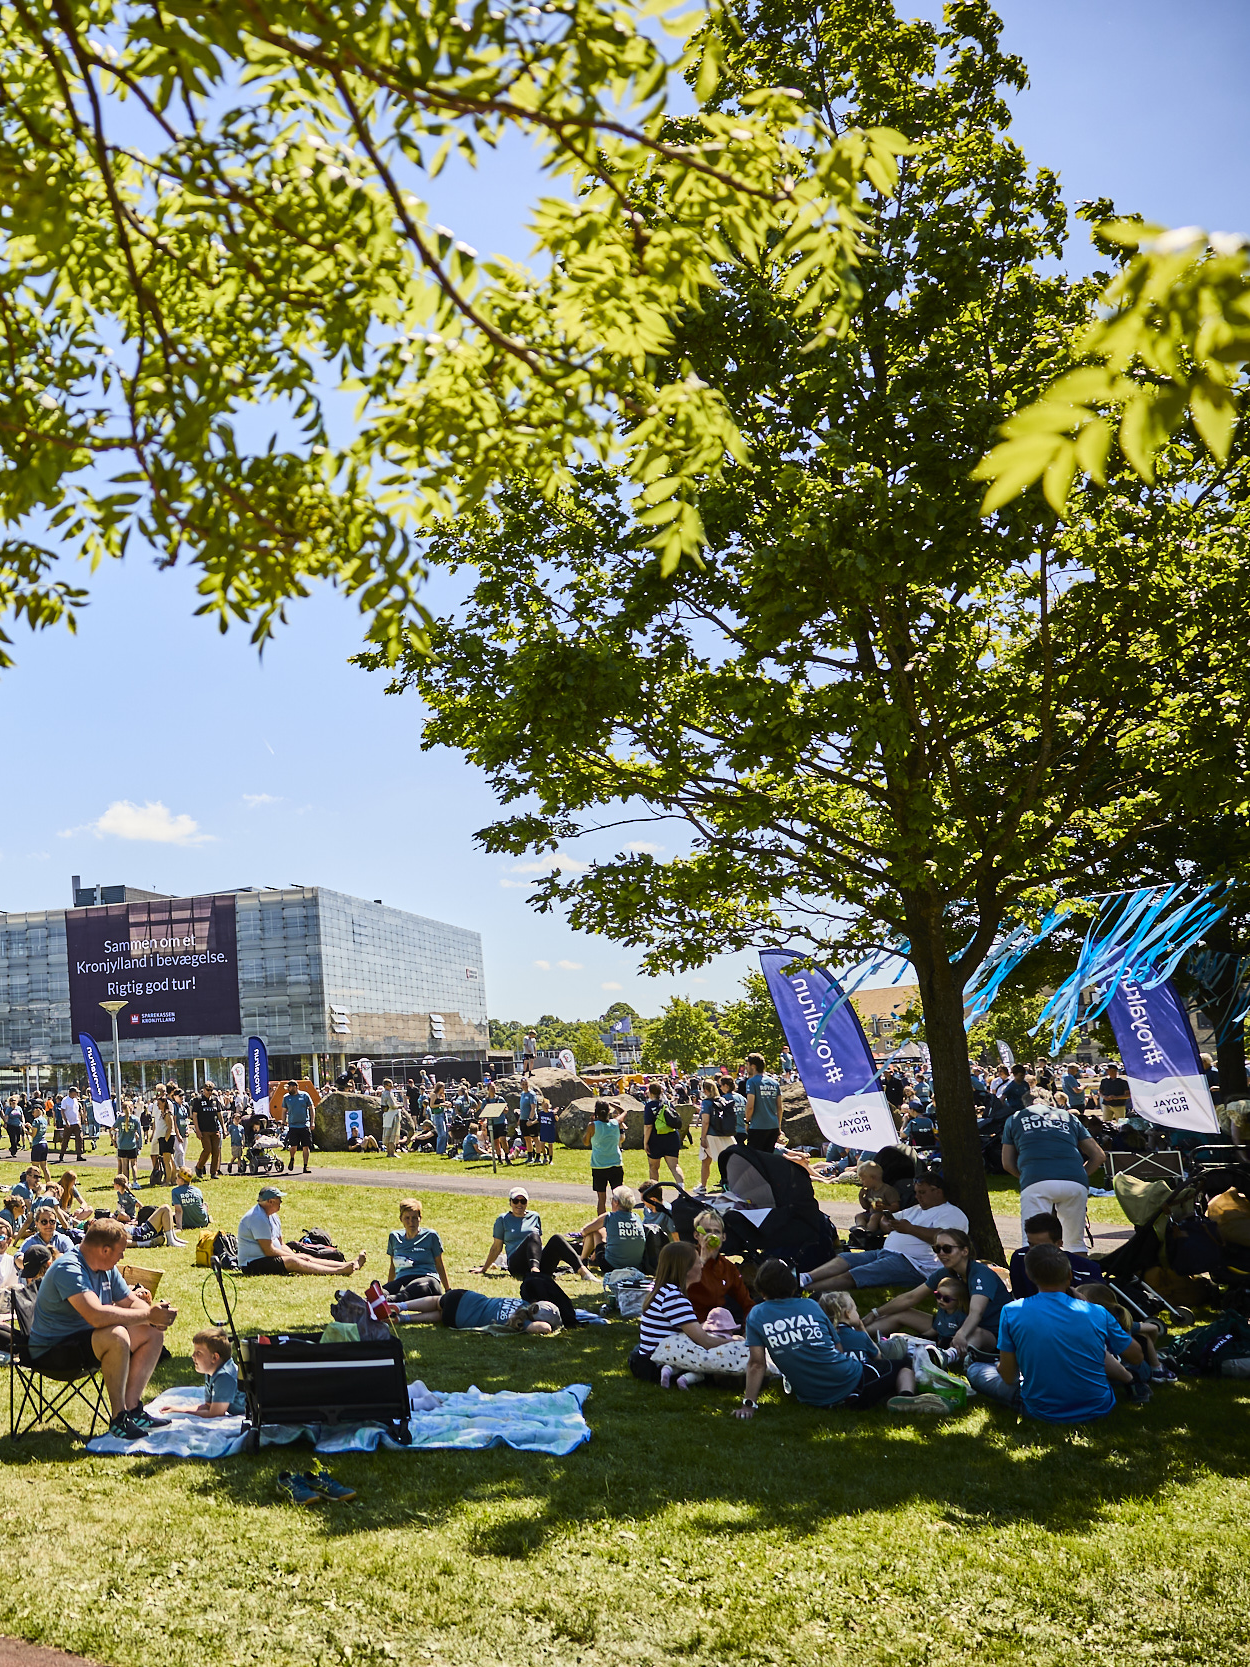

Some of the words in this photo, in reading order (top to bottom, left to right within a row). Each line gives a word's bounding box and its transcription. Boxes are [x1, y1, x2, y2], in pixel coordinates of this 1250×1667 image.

[104, 939, 158, 953] Sammen
[159, 937, 181, 948] om
[183, 934, 196, 946] et
[76, 955, 147, 974] Kronjylland
[149, 954, 154, 967] i
[156, 950, 228, 968] bevægelse.
[107, 979, 143, 996] Rigtig
[145, 977, 169, 995] god
[171, 976, 197, 991] tur!
[762, 1314, 820, 1336] ROYAL
